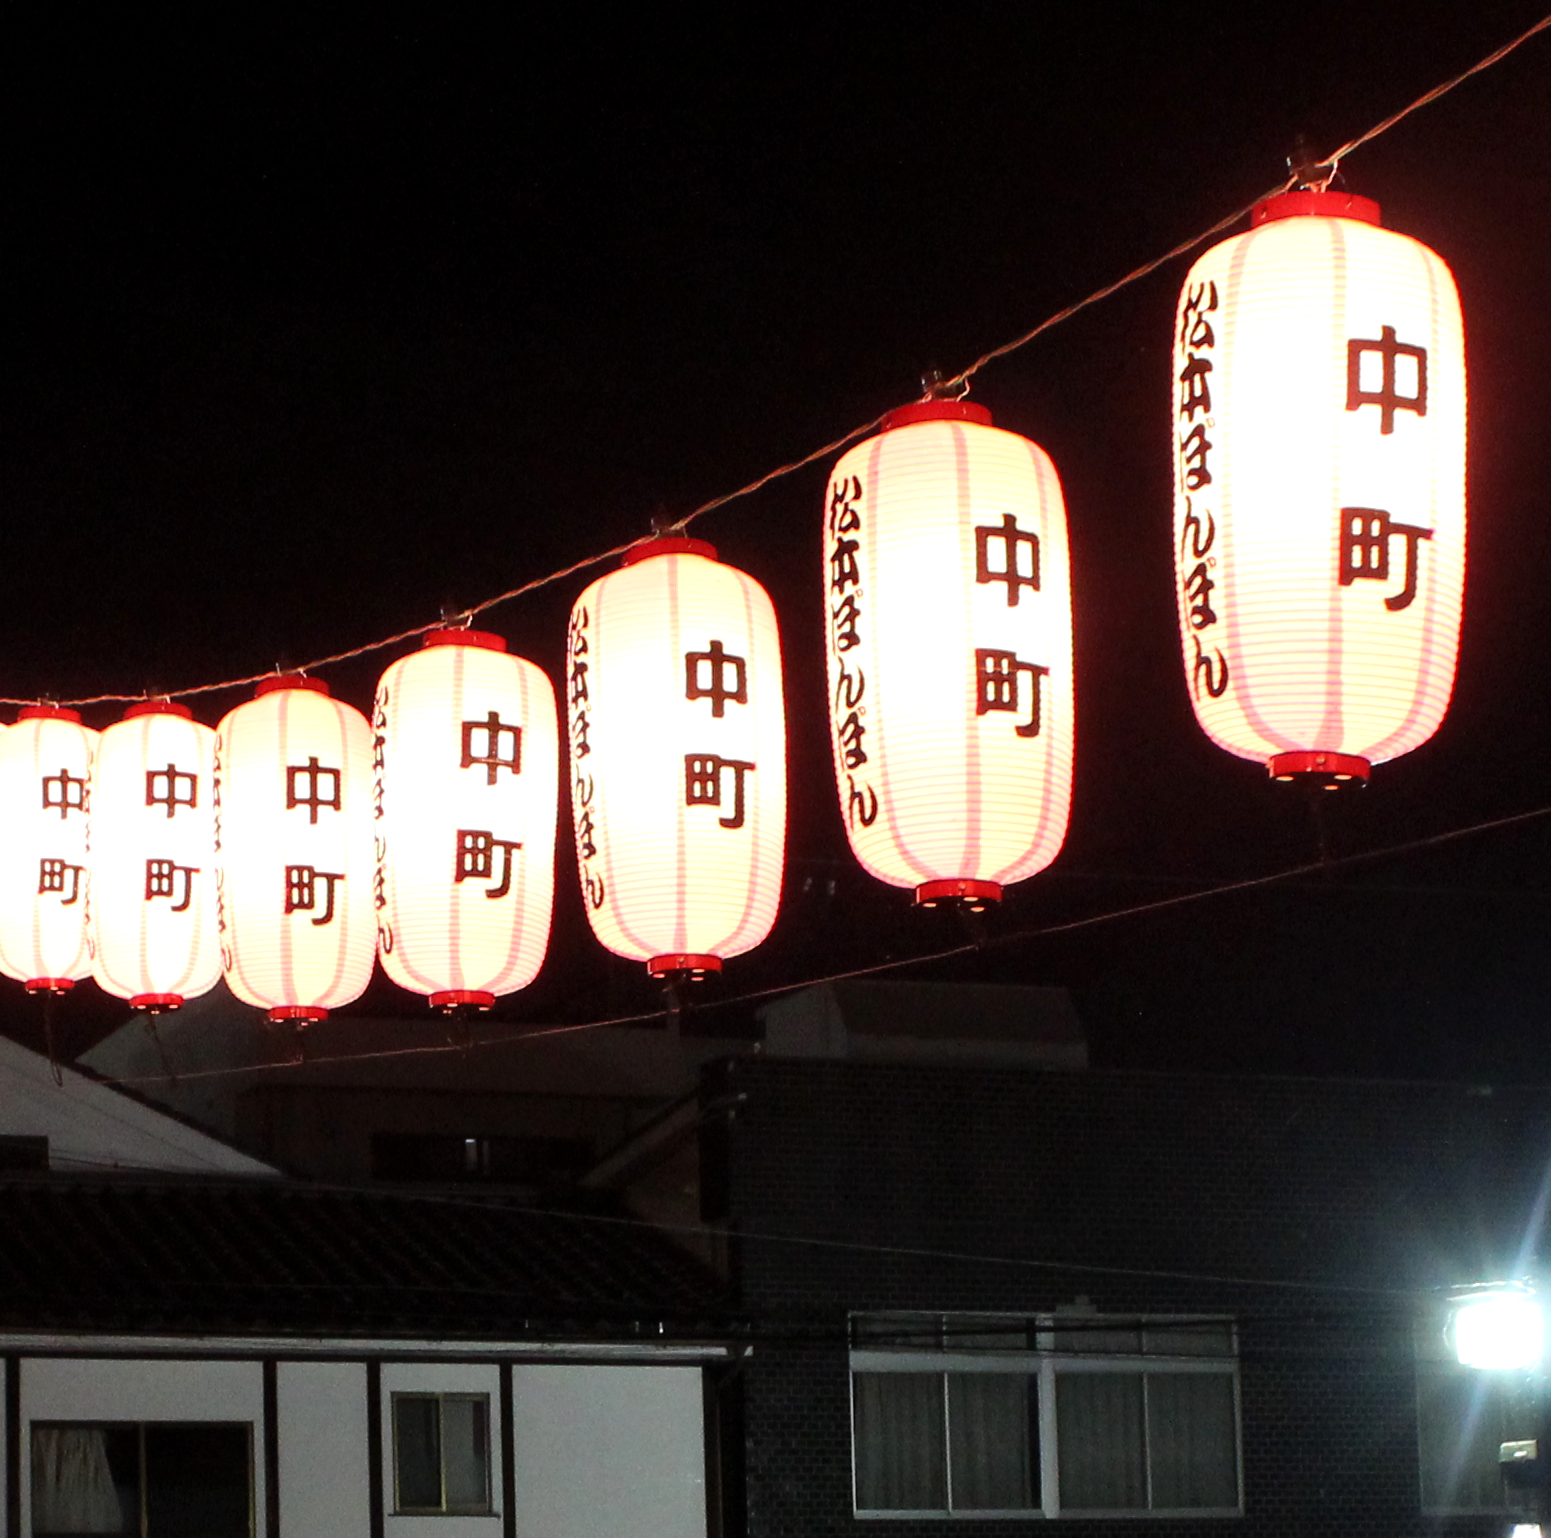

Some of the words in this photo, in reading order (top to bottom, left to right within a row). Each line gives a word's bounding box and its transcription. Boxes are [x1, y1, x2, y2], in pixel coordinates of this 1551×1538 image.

[1338, 326, 1434, 611] 中町
[975, 514, 1050, 738] 中町
[455, 712, 523, 899] 中町
[685, 640, 757, 829] 中町
[39, 769, 85, 906] 中町
[145, 763, 201, 911] 中町
[285, 757, 344, 925] 中町
